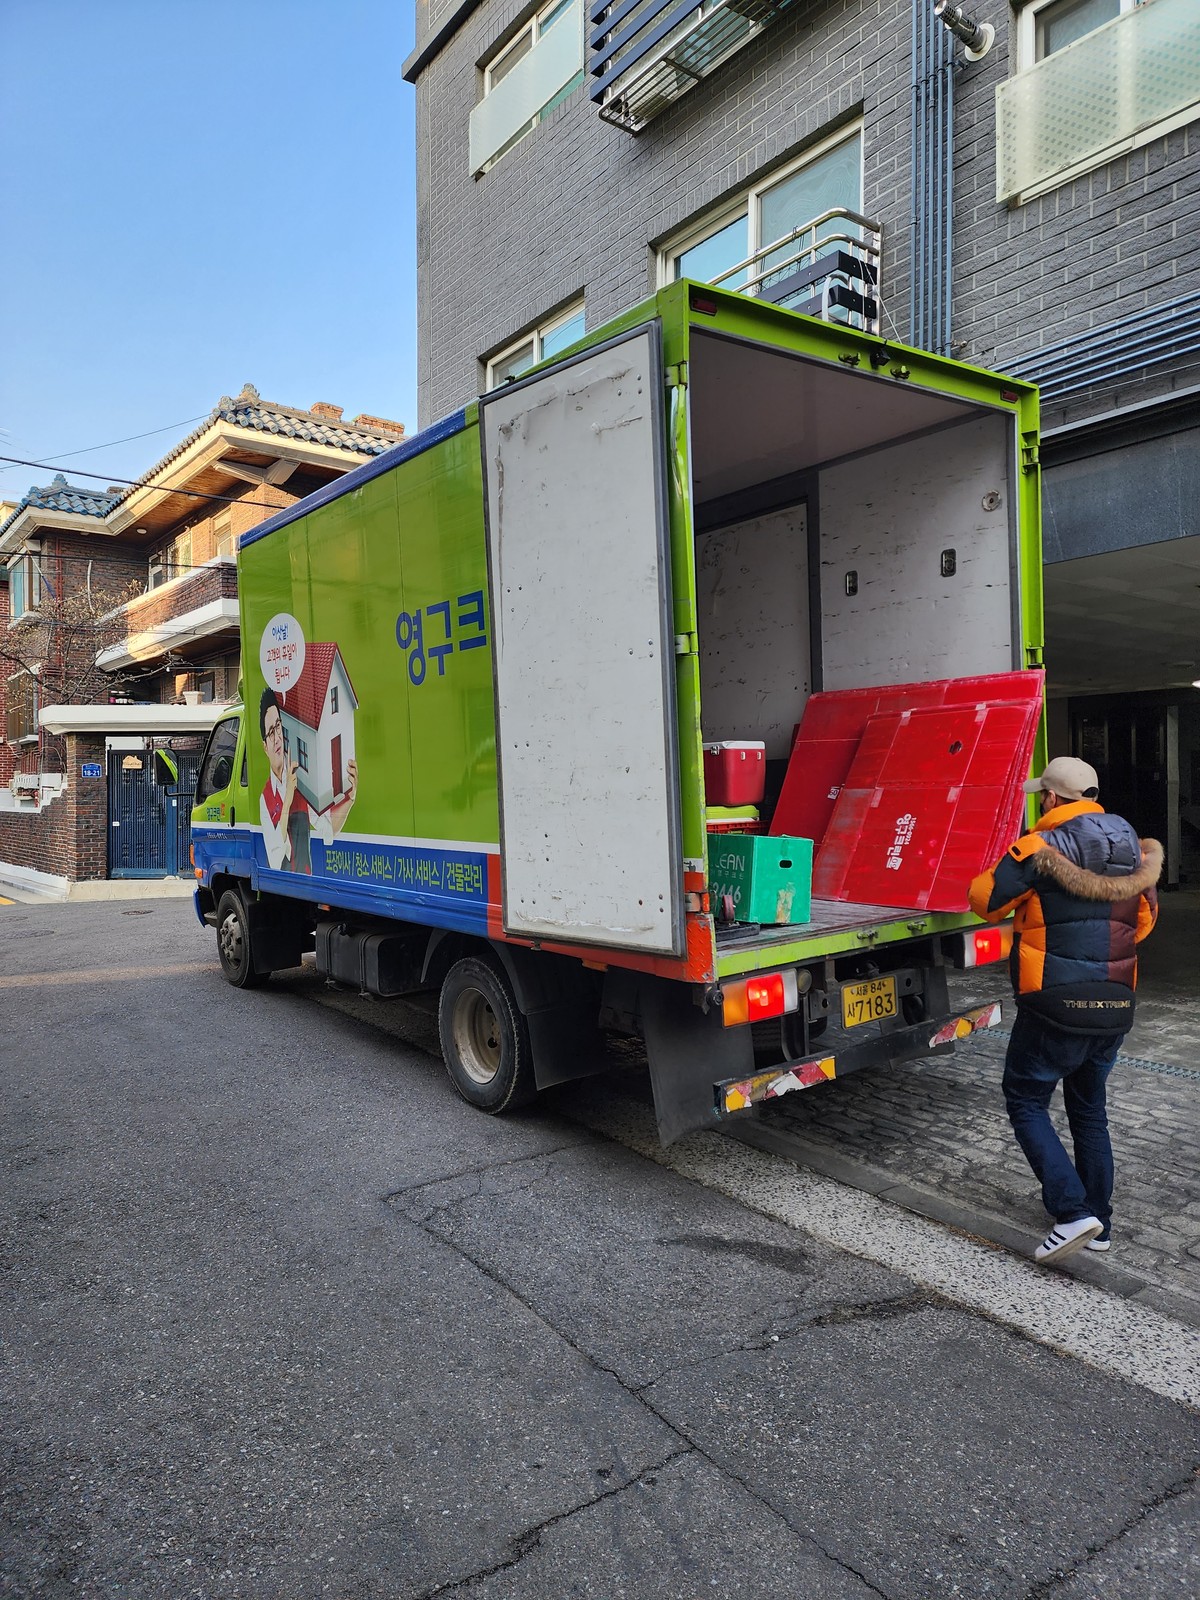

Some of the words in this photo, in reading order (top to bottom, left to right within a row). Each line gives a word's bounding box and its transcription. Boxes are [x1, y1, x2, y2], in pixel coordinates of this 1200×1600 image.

[272, 623, 289, 641] 이삿날!
[396, 590, 487, 686] 영구크
[267, 647, 281, 664] 고객의
[282, 643, 298, 661] 휴일이
[275, 666, 291, 684] 됩니다
[886, 813, 912, 856] 영구크린
[326, 850, 350, 875] 포장이사
[355, 853, 369, 878] 청소
[371, 855, 393, 880] 서비스
[398, 858, 413, 884] 가사
[415, 859, 440, 887] 서비스
[446, 862, 483, 894] 건물관리
[856, 984, 868, 996] 서울
[870, 981, 882, 994] 84
[1063, 999, 1087, 1009] THE
